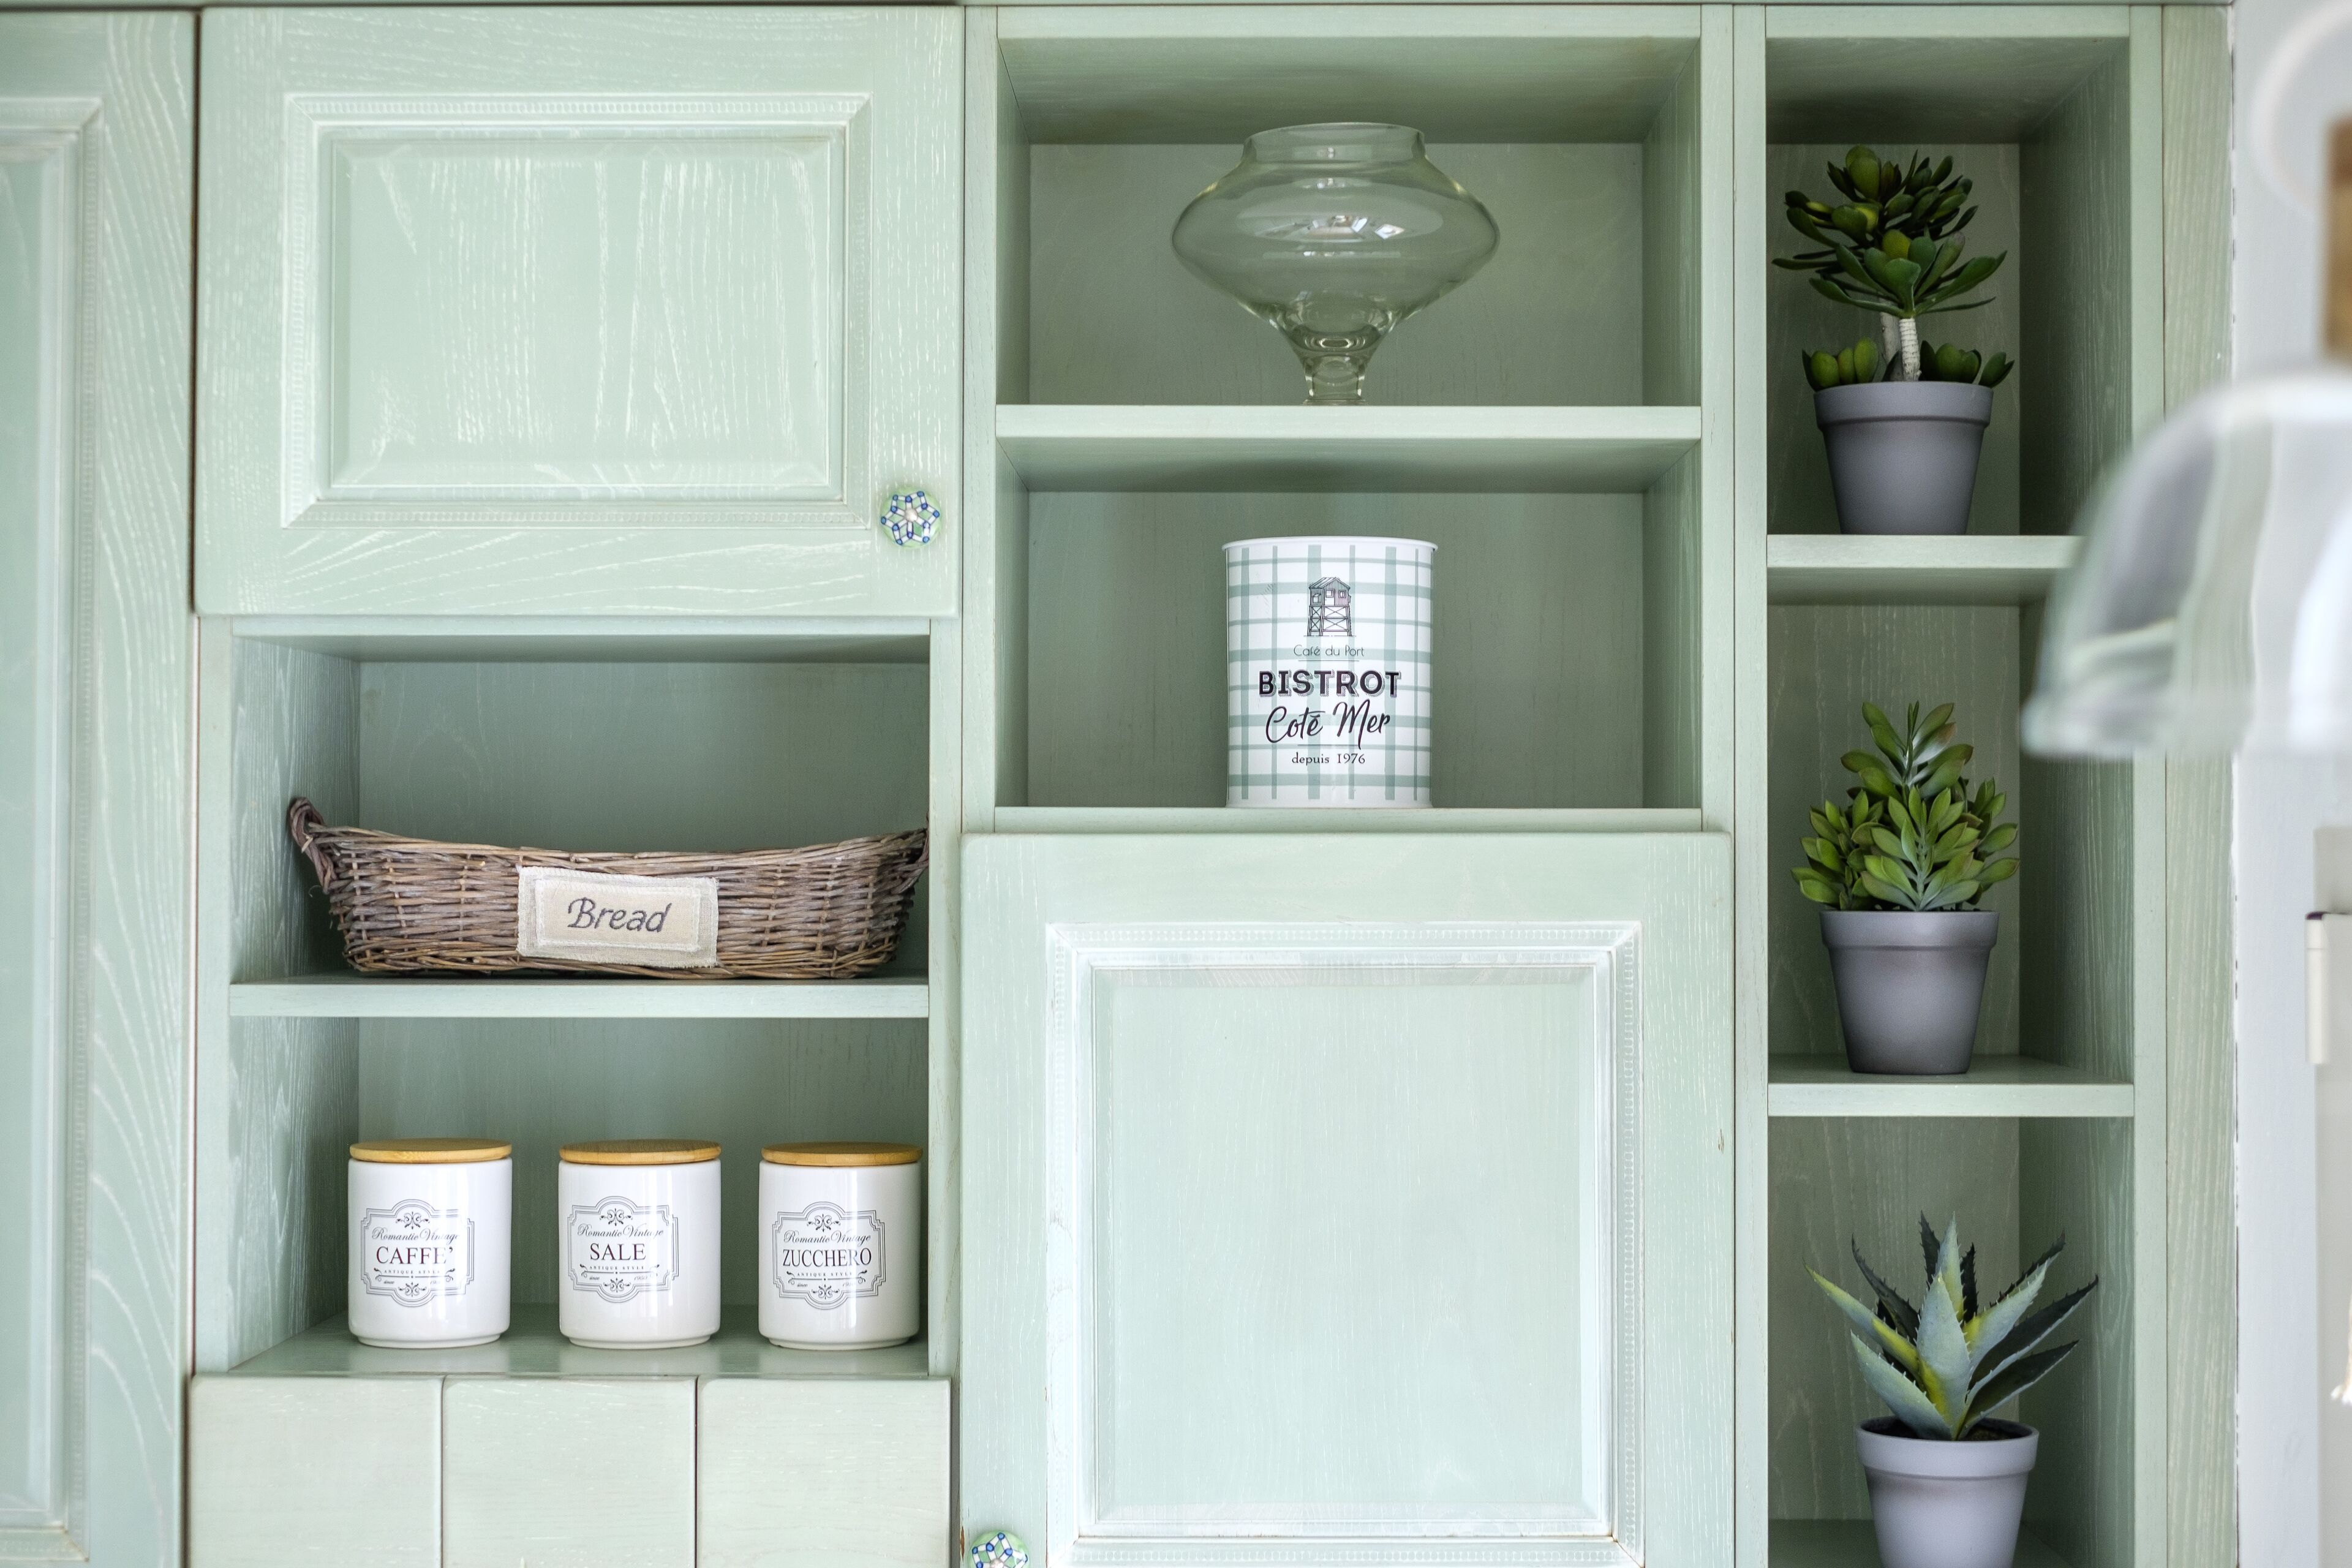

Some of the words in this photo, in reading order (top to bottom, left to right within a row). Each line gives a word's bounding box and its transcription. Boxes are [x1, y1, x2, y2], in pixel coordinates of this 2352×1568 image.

[1293, 644, 1321, 657] Café
[1325, 644, 1340, 657] du
[1344, 644, 1365, 657] Port
[1259, 669, 1402, 698] BISTROT
[1332, 699, 1391, 750] Mer
[1291, 752, 1330, 766] depuis
[1336, 752, 1366, 765] 1976
[567, 897, 673, 933] Bread
[372, 1226, 419, 1241] Romantic
[577, 1223, 622, 1237] Romantic
[783, 1230, 830, 1243] Romantic
[590, 1242, 646, 1261] SALE
[783, 1247, 872, 1267] ZUCCHERO
